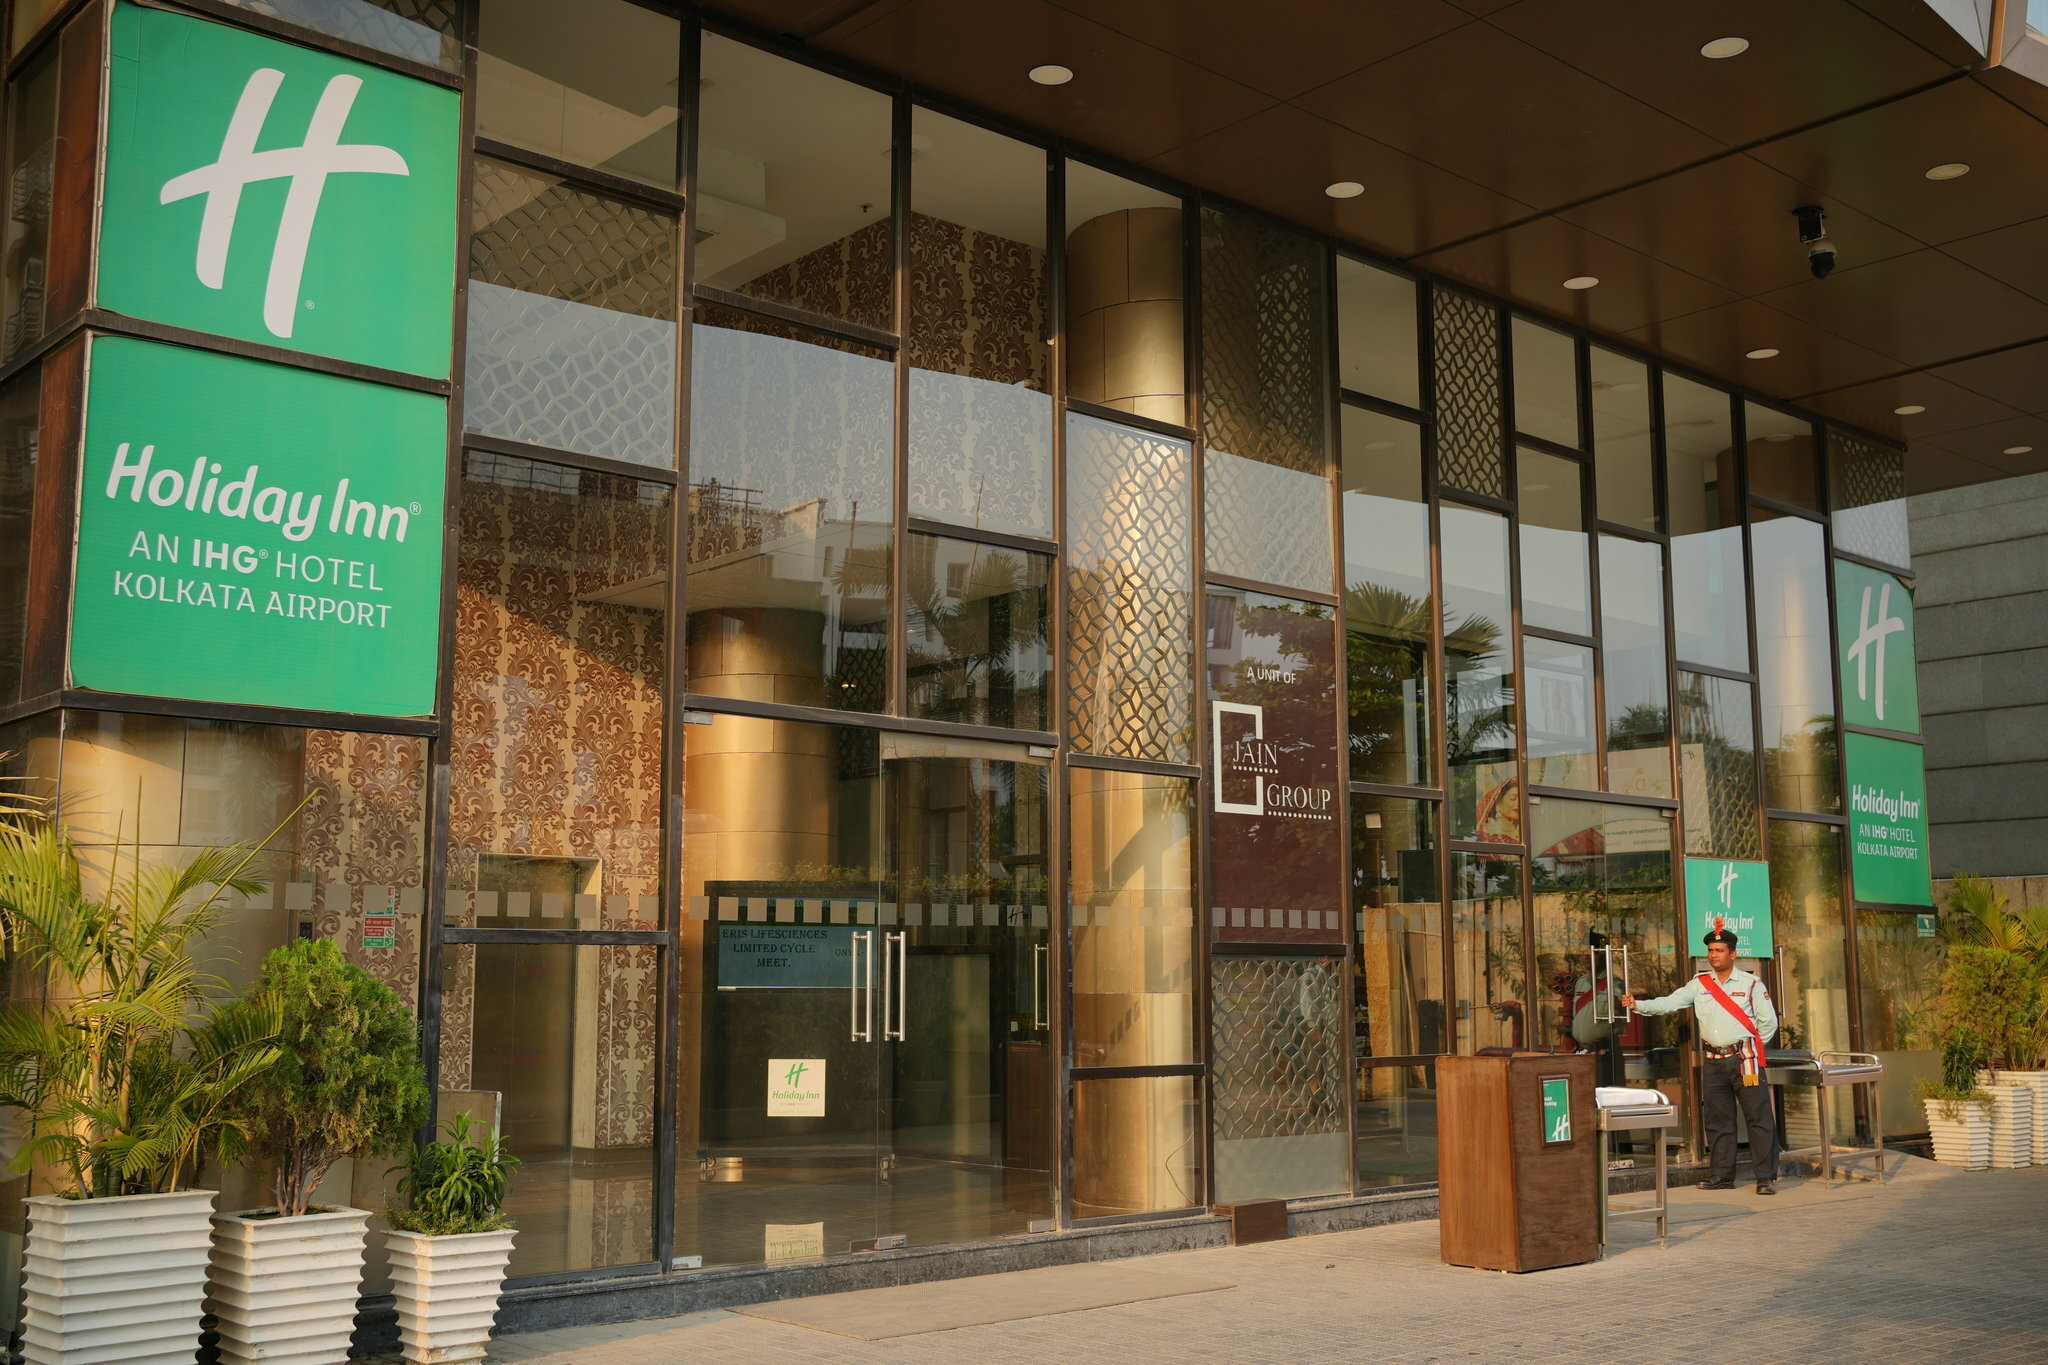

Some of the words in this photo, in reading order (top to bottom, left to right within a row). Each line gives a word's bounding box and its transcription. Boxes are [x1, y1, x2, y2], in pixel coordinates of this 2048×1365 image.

[106, 442, 322, 541] Holiday
[128, 530, 180, 564] AN
[276, 550, 384, 591] HOTEL
[114, 570, 256, 612] KOLKATA
[265, 591, 392, 628] AIRPORT
[1247, 666, 1254, 679] A
[1257, 668, 1280, 682] UNIT
[1283, 671, 1296, 684] OF
[1233, 740, 1277, 765] JAIN
[1266, 783, 1331, 810] GROUP
[1852, 784, 1898, 823] Holiday
[1859, 823, 1870, 837] AN
[1890, 826, 1915, 843] HOTEL
[1857, 842, 1888, 857] KOLKATA
[1889, 846, 1918, 860] AIRPORT
[1705, 911, 1738, 933] Hoday
[722, 929, 748, 939] ERIS
[750, 929, 828, 939] LIFESCIENCES
[1737, 936, 1750, 946] OTEL
[733, 943, 777, 953] LIMITED
[780, 943, 816, 954] CYCLE
[757, 958, 791, 968] MEET.
[772, 1090, 805, 1101] Holiday
[806, 1090, 820, 1099] Inn
